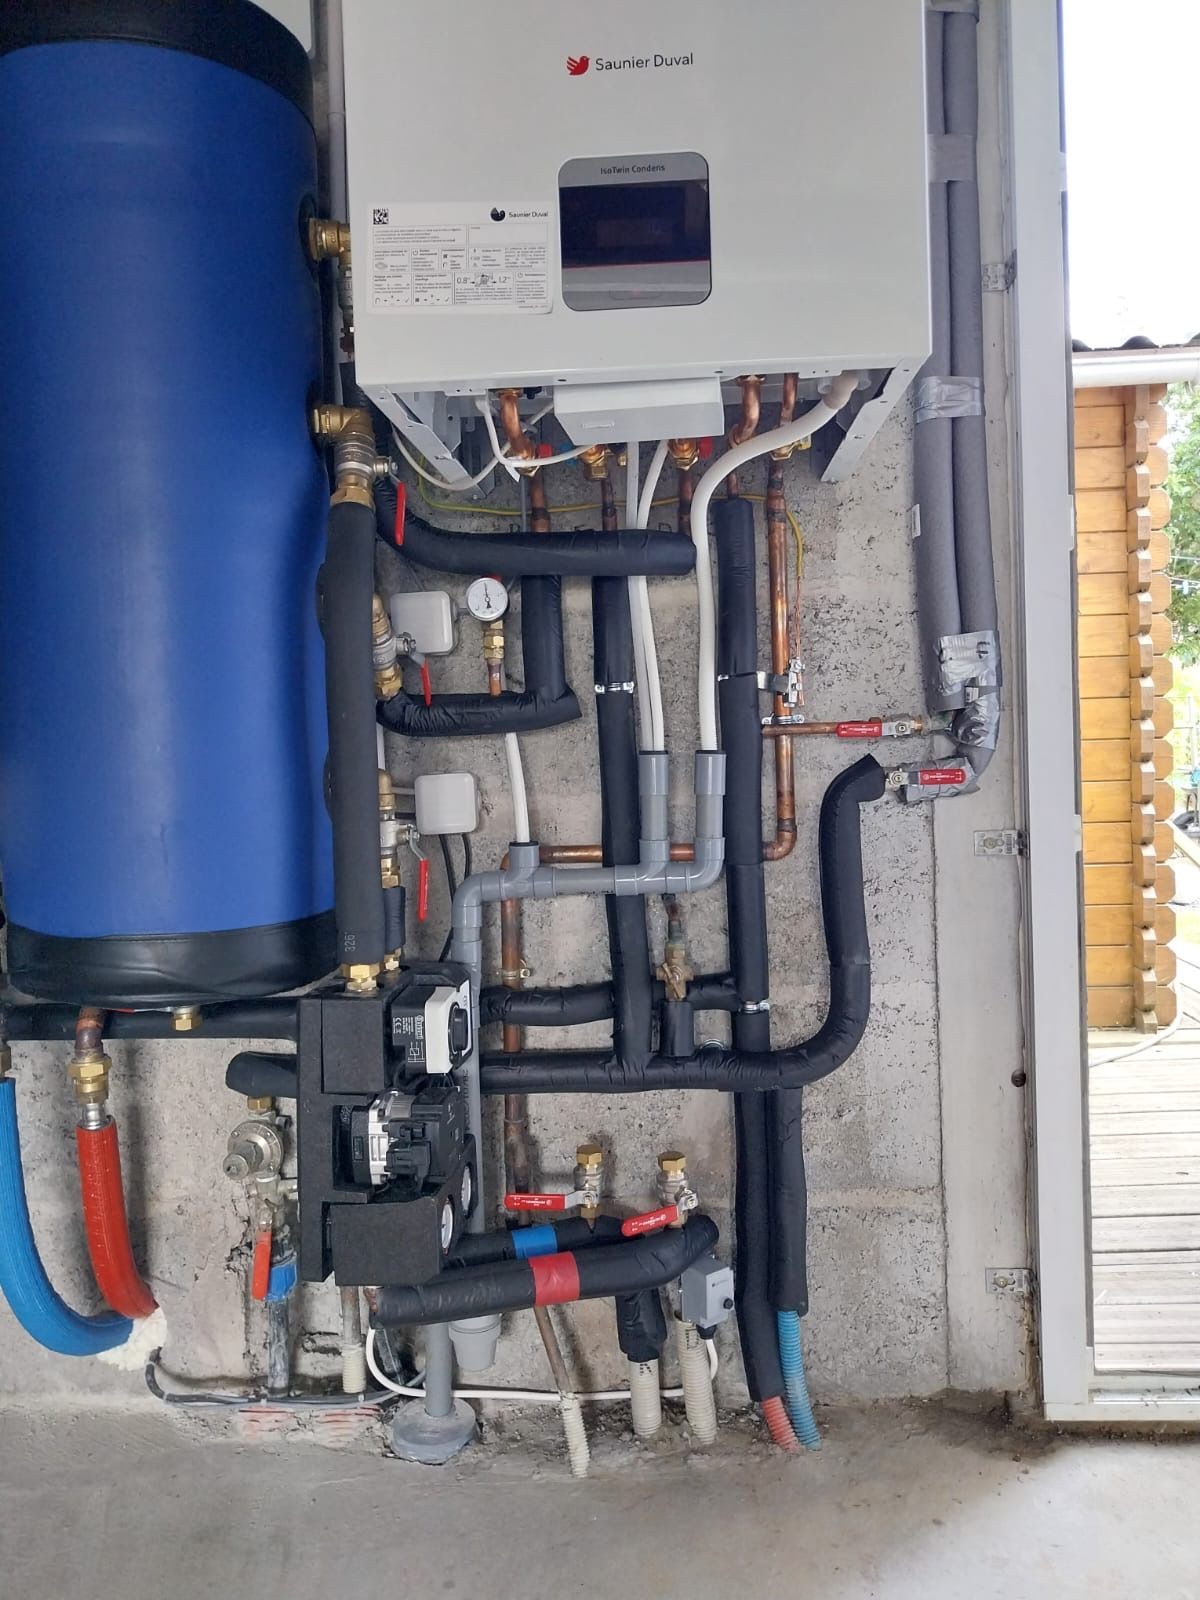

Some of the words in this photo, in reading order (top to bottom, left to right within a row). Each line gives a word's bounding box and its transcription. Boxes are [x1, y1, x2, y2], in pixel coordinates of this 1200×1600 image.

[595, 56, 651, 71] Saunier
[653, 52, 694, 68] Duval
[600, 166, 630, 175] IsoTwin
[631, 164, 666, 173] Condens
